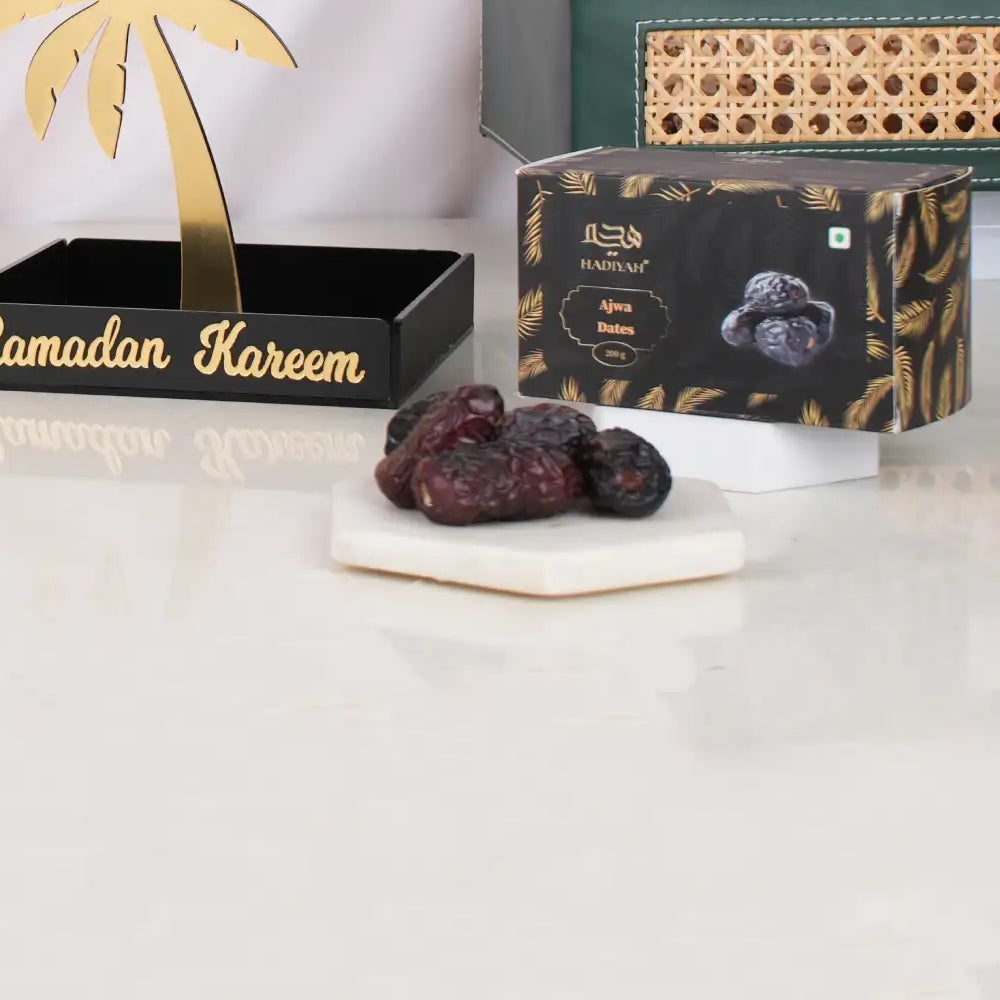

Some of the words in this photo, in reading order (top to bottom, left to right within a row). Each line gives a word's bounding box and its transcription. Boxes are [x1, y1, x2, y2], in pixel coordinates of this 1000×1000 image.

[599, 299, 633, 315] Ajwa
[597, 321, 635, 336] Dates
[193, 319, 366, 385] Kareem
